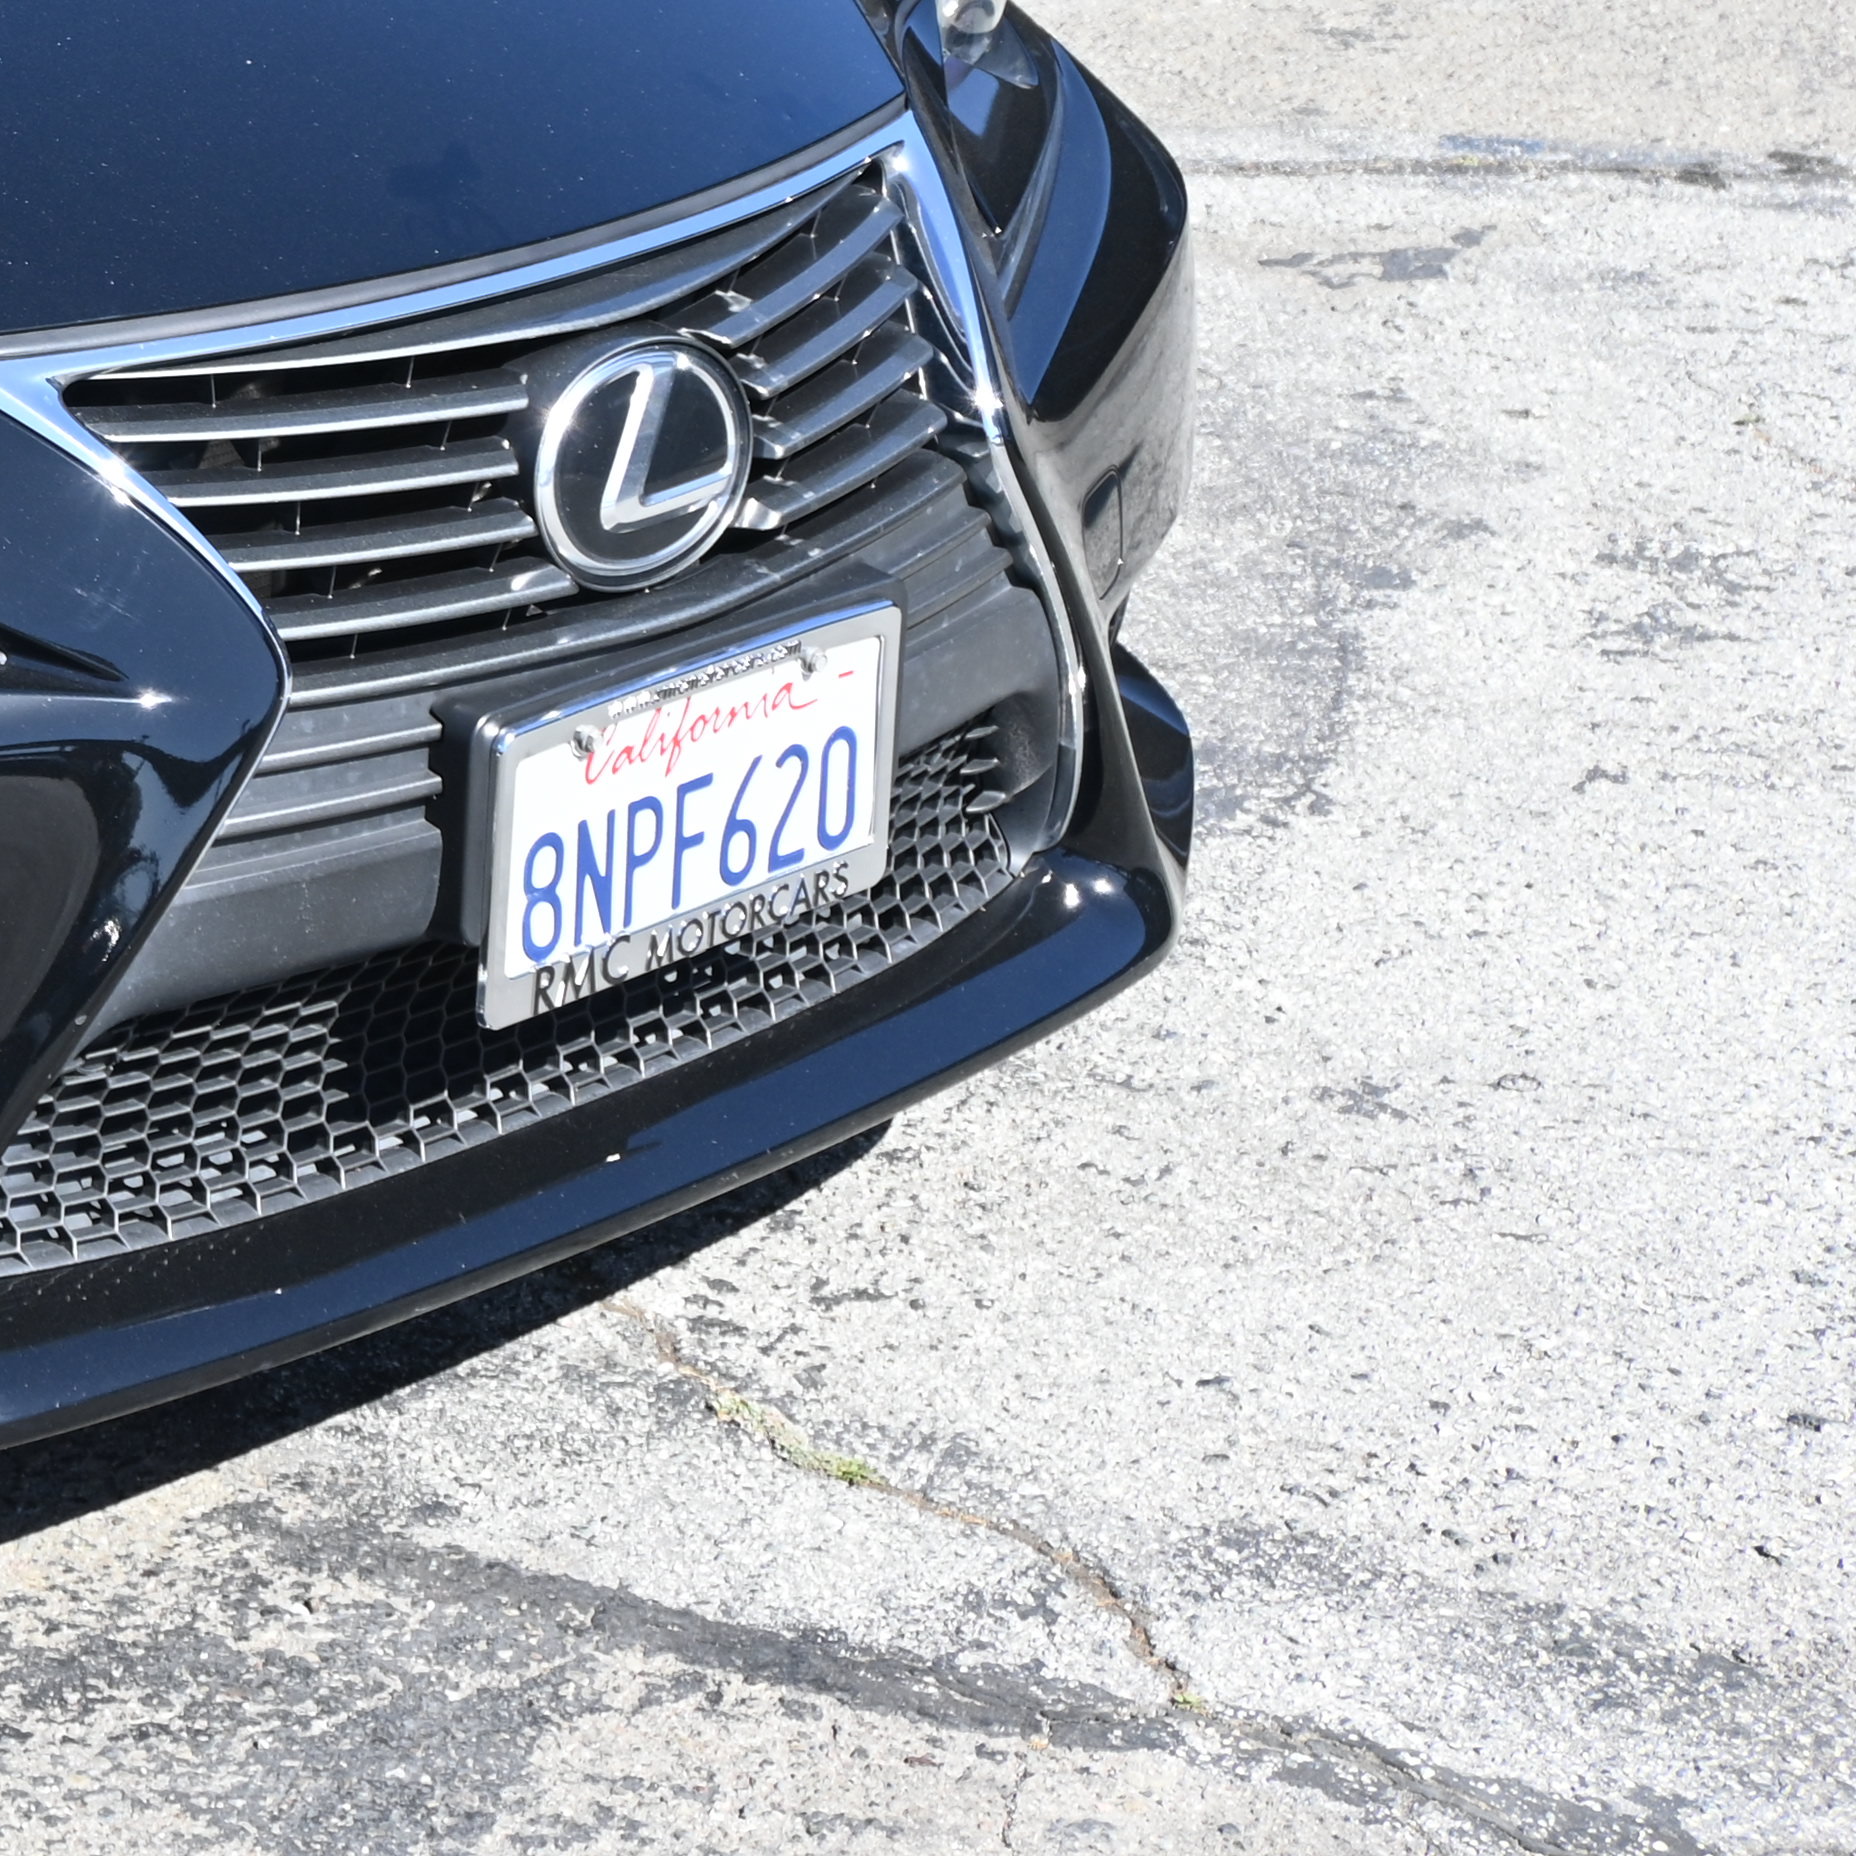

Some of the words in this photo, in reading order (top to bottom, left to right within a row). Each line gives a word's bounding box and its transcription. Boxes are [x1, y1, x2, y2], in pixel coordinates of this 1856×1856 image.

[585, 681, 818, 785] California
[521, 725, 858, 962] 8NPF620
[532, 931, 631, 1017] RMC
[645, 859, 850, 971] MOTORCARS
